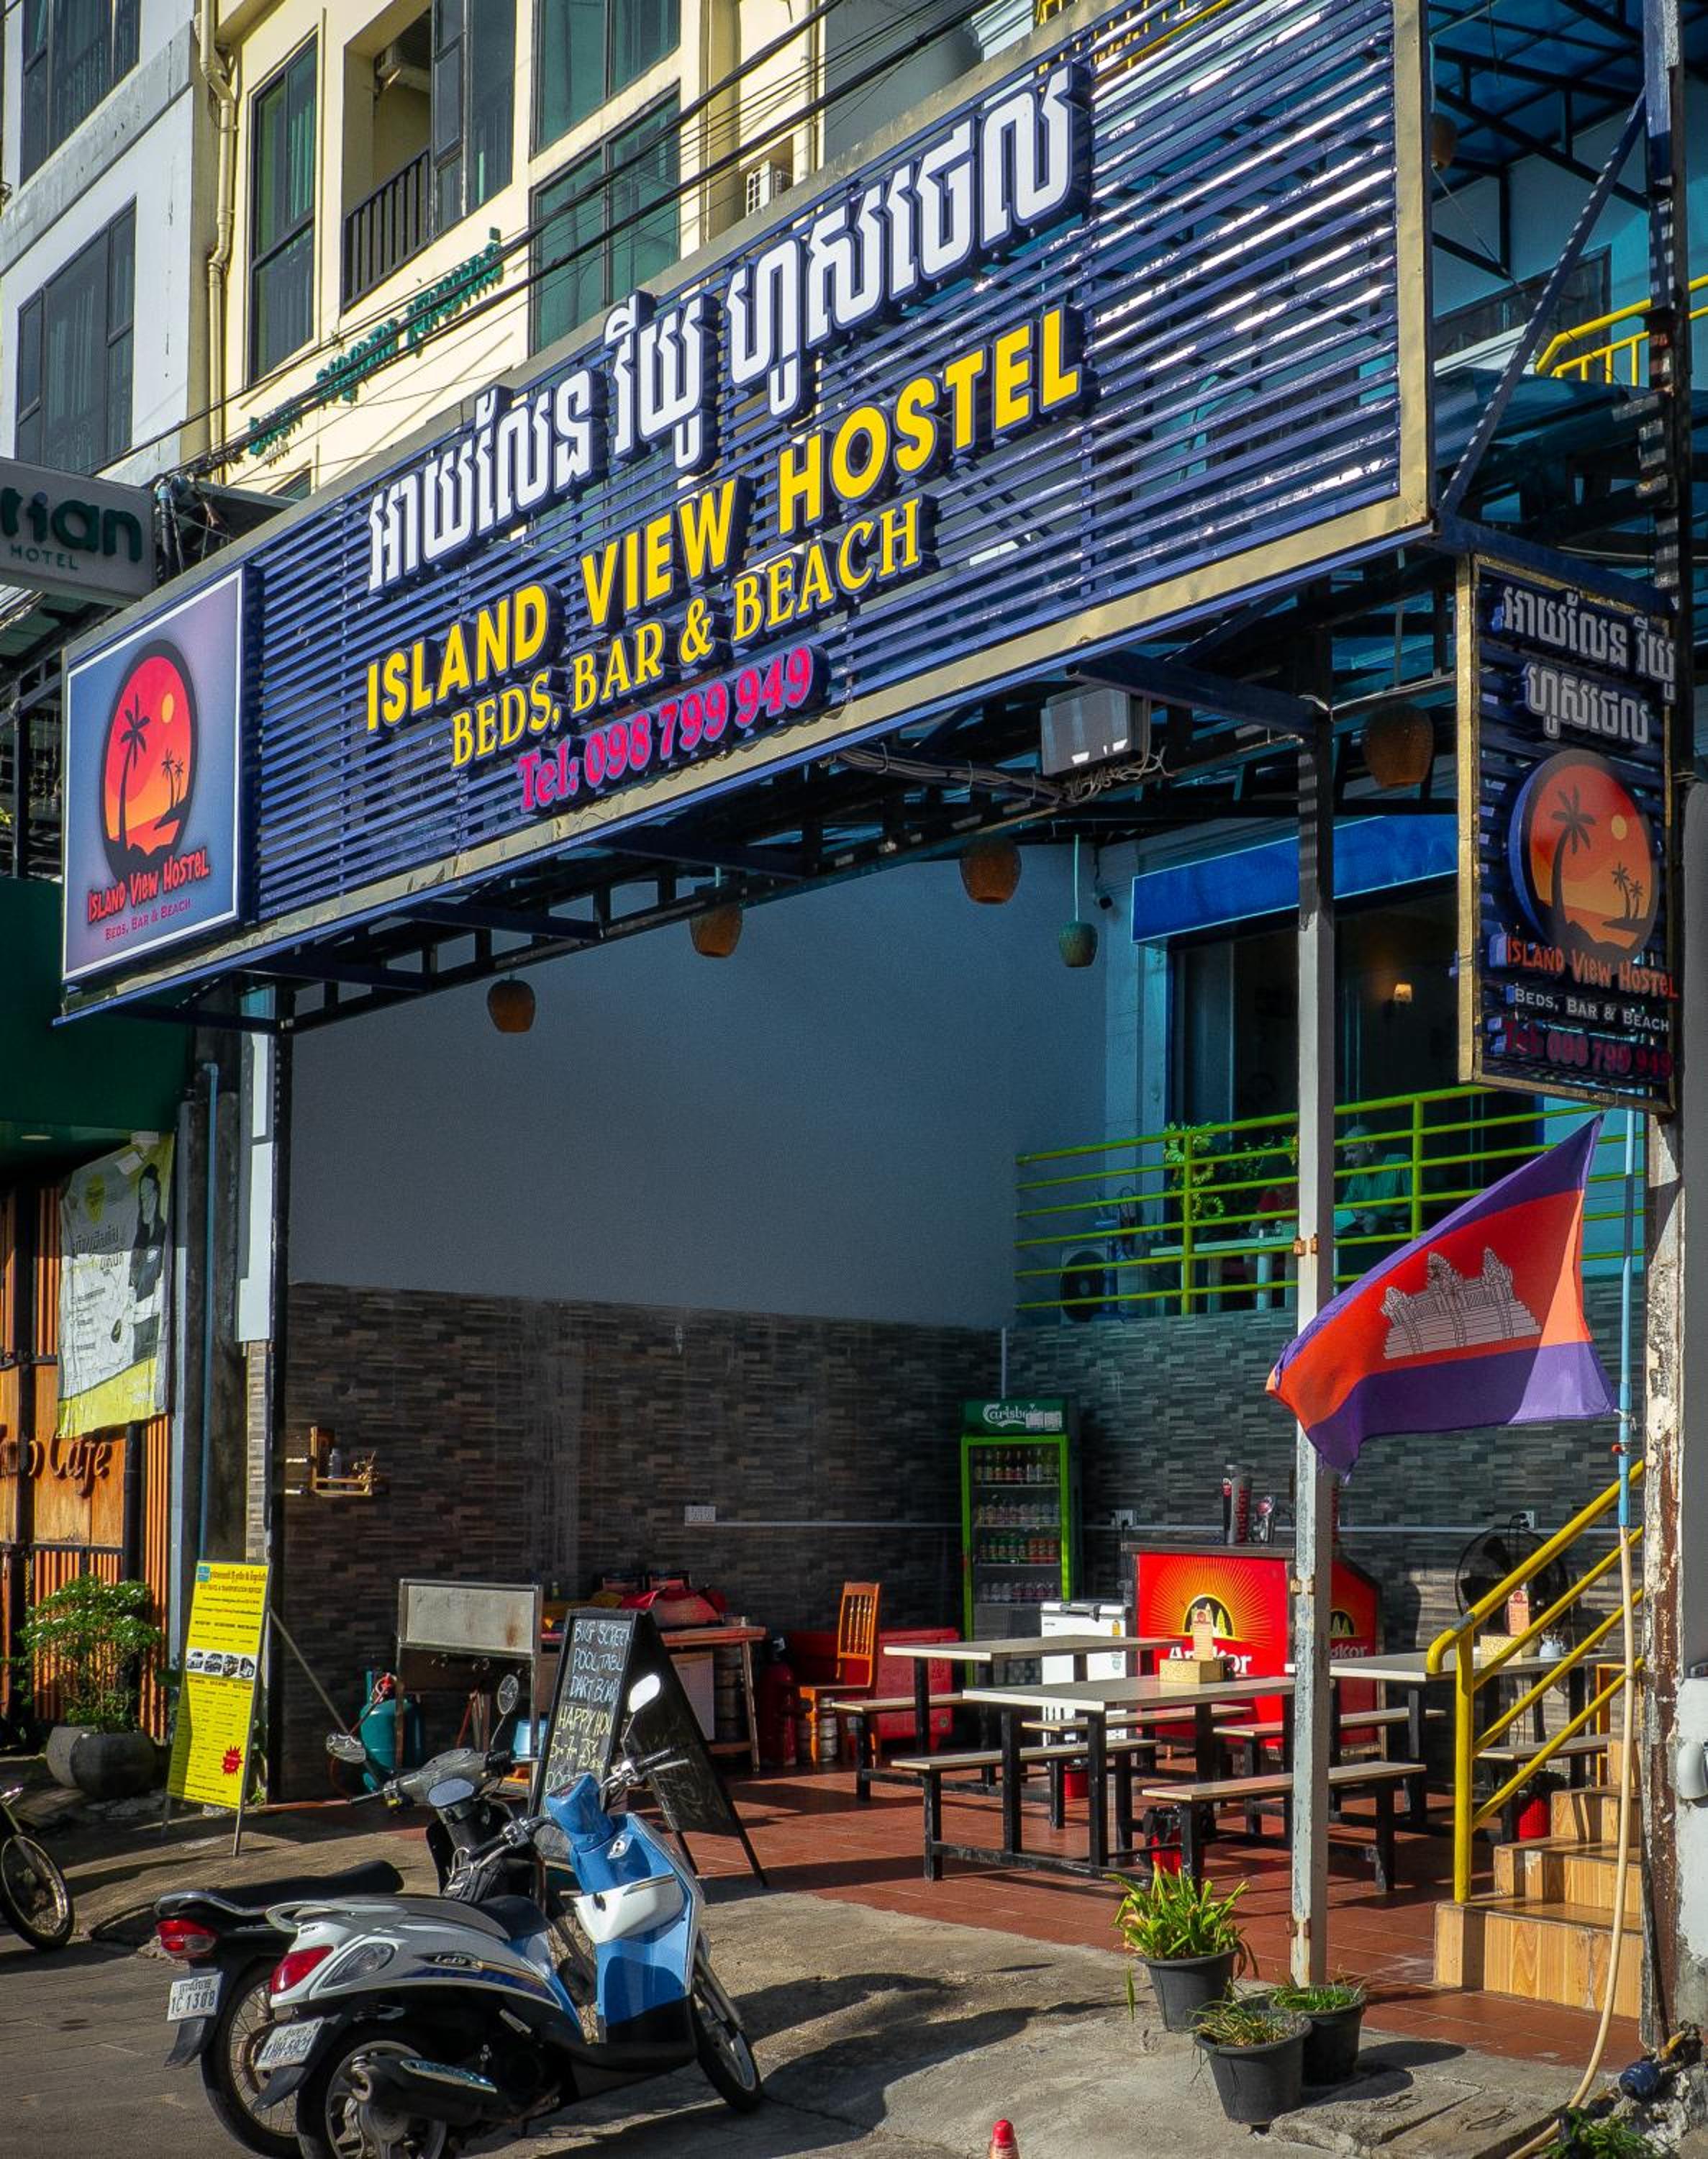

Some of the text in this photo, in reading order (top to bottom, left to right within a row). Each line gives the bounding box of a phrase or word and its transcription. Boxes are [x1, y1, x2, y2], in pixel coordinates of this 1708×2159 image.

[11, 545, 79, 570] HOTEL
[367, 309, 1078, 730] ISLAND VIEW HOSTEL
[452, 498, 920, 768] BEDS, BAR & BEACH
[518, 646, 812, 811] Tel: 098 799 949
